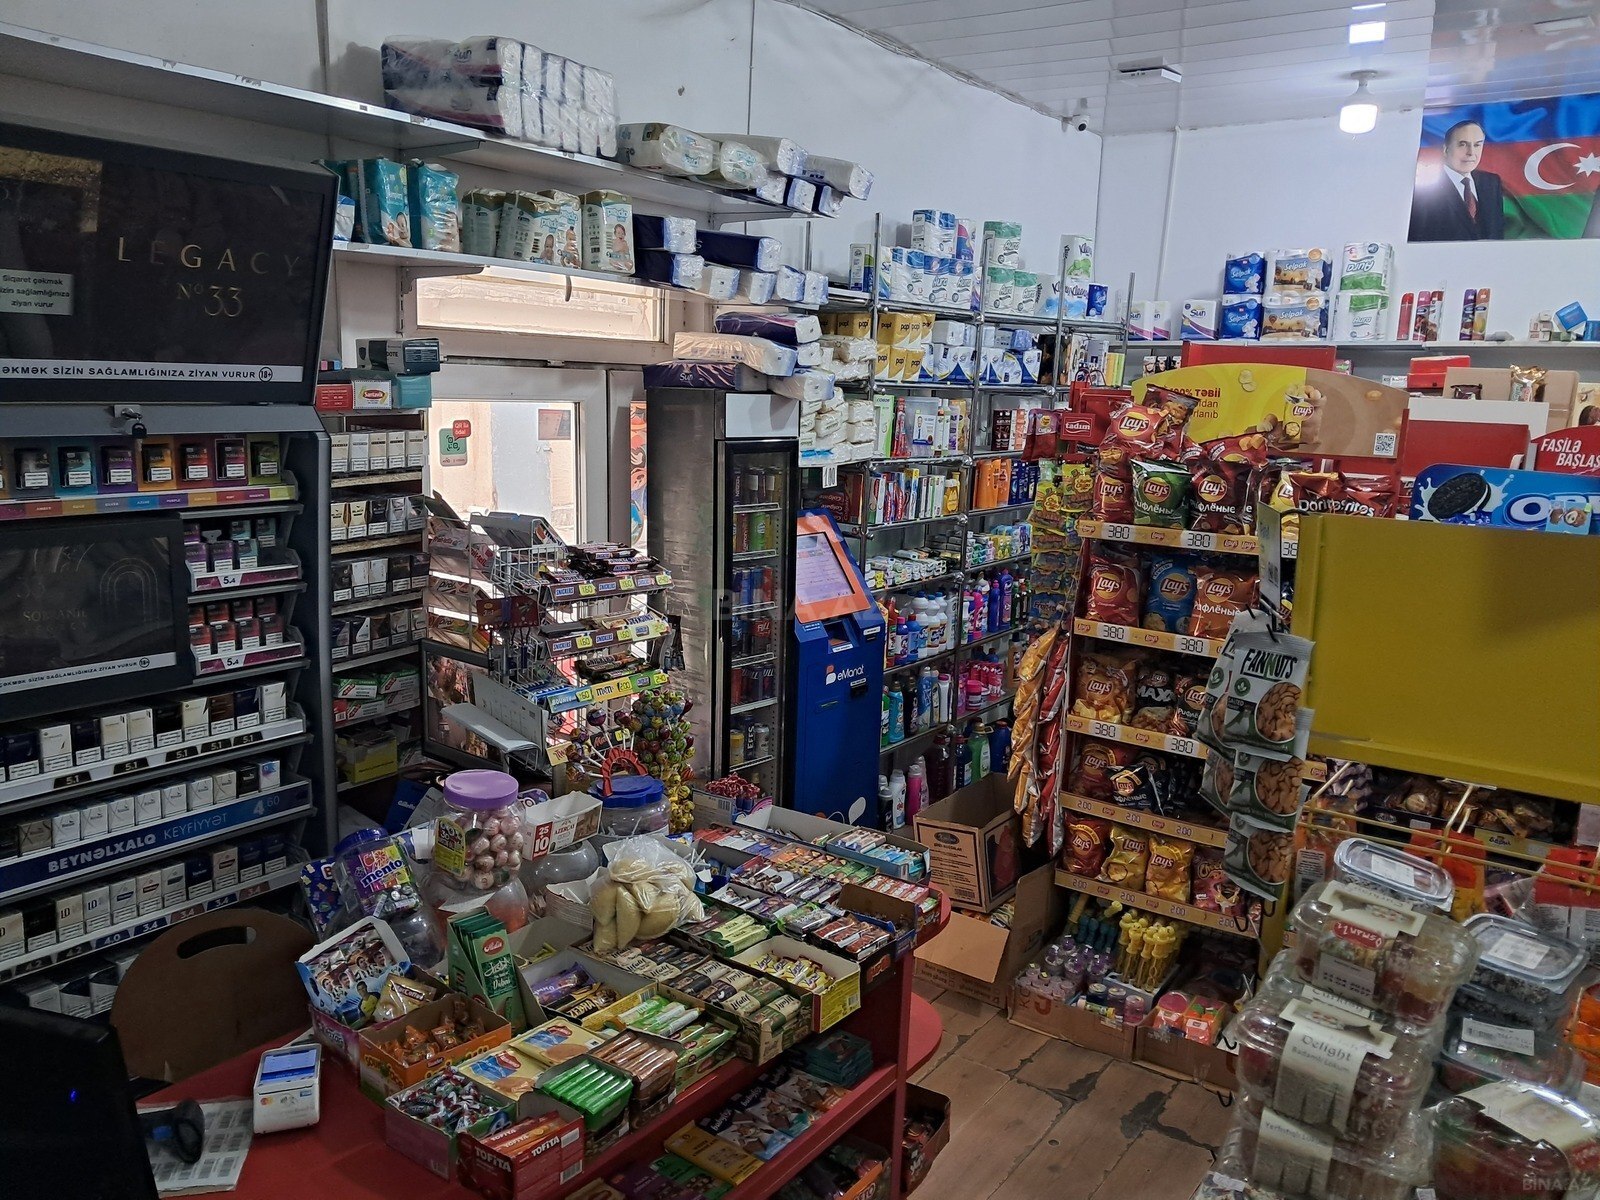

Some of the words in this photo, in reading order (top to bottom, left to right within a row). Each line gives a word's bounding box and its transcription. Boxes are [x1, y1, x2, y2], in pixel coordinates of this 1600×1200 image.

[1285, 261, 1308, 271] Selpak
[1231, 268, 1252, 279] Selpak
[1190, 309, 1206, 318] Sun
[1229, 313, 1250, 323] Selpak
[1281, 309, 1303, 319] Selpak
[1144, 481, 1169, 497] Lays
[1201, 479, 1226, 496] Lays
[1097, 578, 1120, 592] Lays
[1161, 579, 1189, 594] Lays
[1206, 582, 1232, 596] Lays
[1103, 625, 1125, 640] 380
[1181, 637, 1203, 653] 380
[1088, 680, 1111, 694] Lays
[1095, 722, 1116, 738] 380
[243, 734, 255, 743] 5.1
[1171, 738, 1194, 753] 380
[211, 742, 223, 751] 5.1
[176, 750, 188, 759] 5.1
[125, 762, 138, 771] 5.1
[66, 774, 80, 784] 5.1
[535, 836, 549, 853] 10
[48, 832, 157, 874] BEYNƏLXALQ
[1151, 854, 1174, 868] Lays
[143, 921, 158, 932] 3.4
